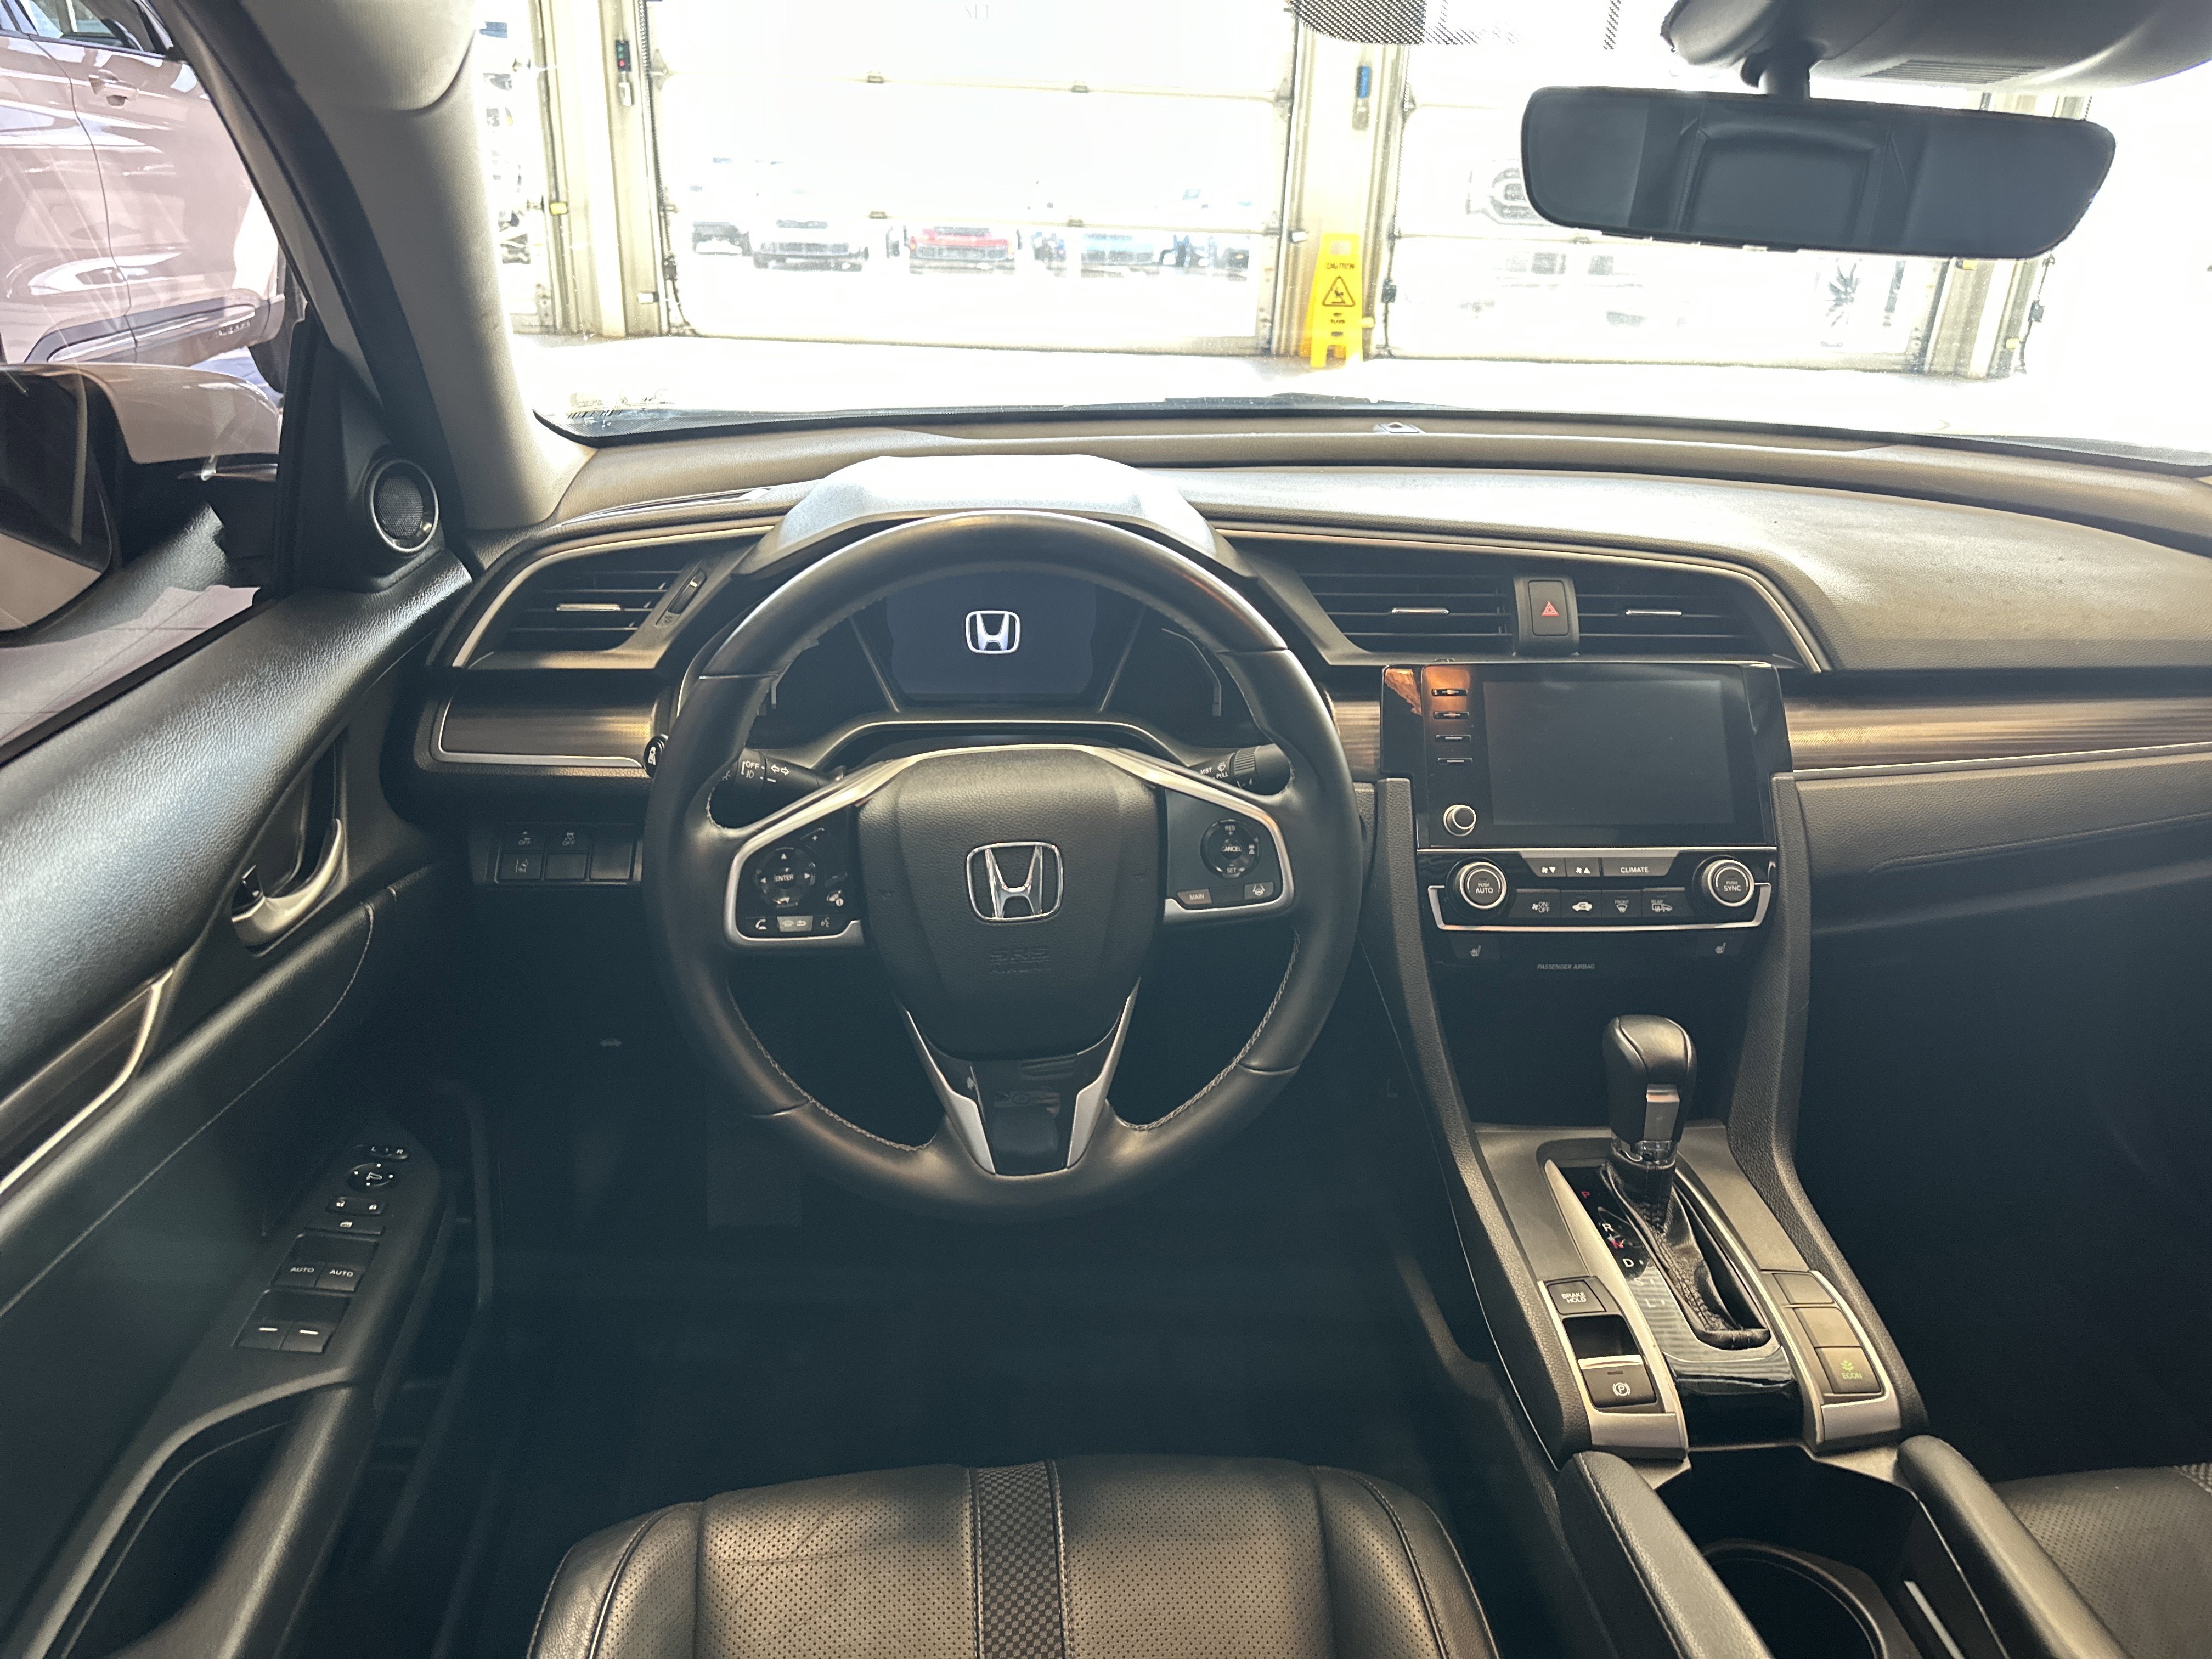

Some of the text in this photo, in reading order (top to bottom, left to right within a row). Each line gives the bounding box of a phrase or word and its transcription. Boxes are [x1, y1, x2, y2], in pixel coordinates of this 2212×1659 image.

[1602, 1223, 1613, 1232] R
[1622, 1259, 1634, 1267] D
[1634, 1277, 1644, 1286] S
